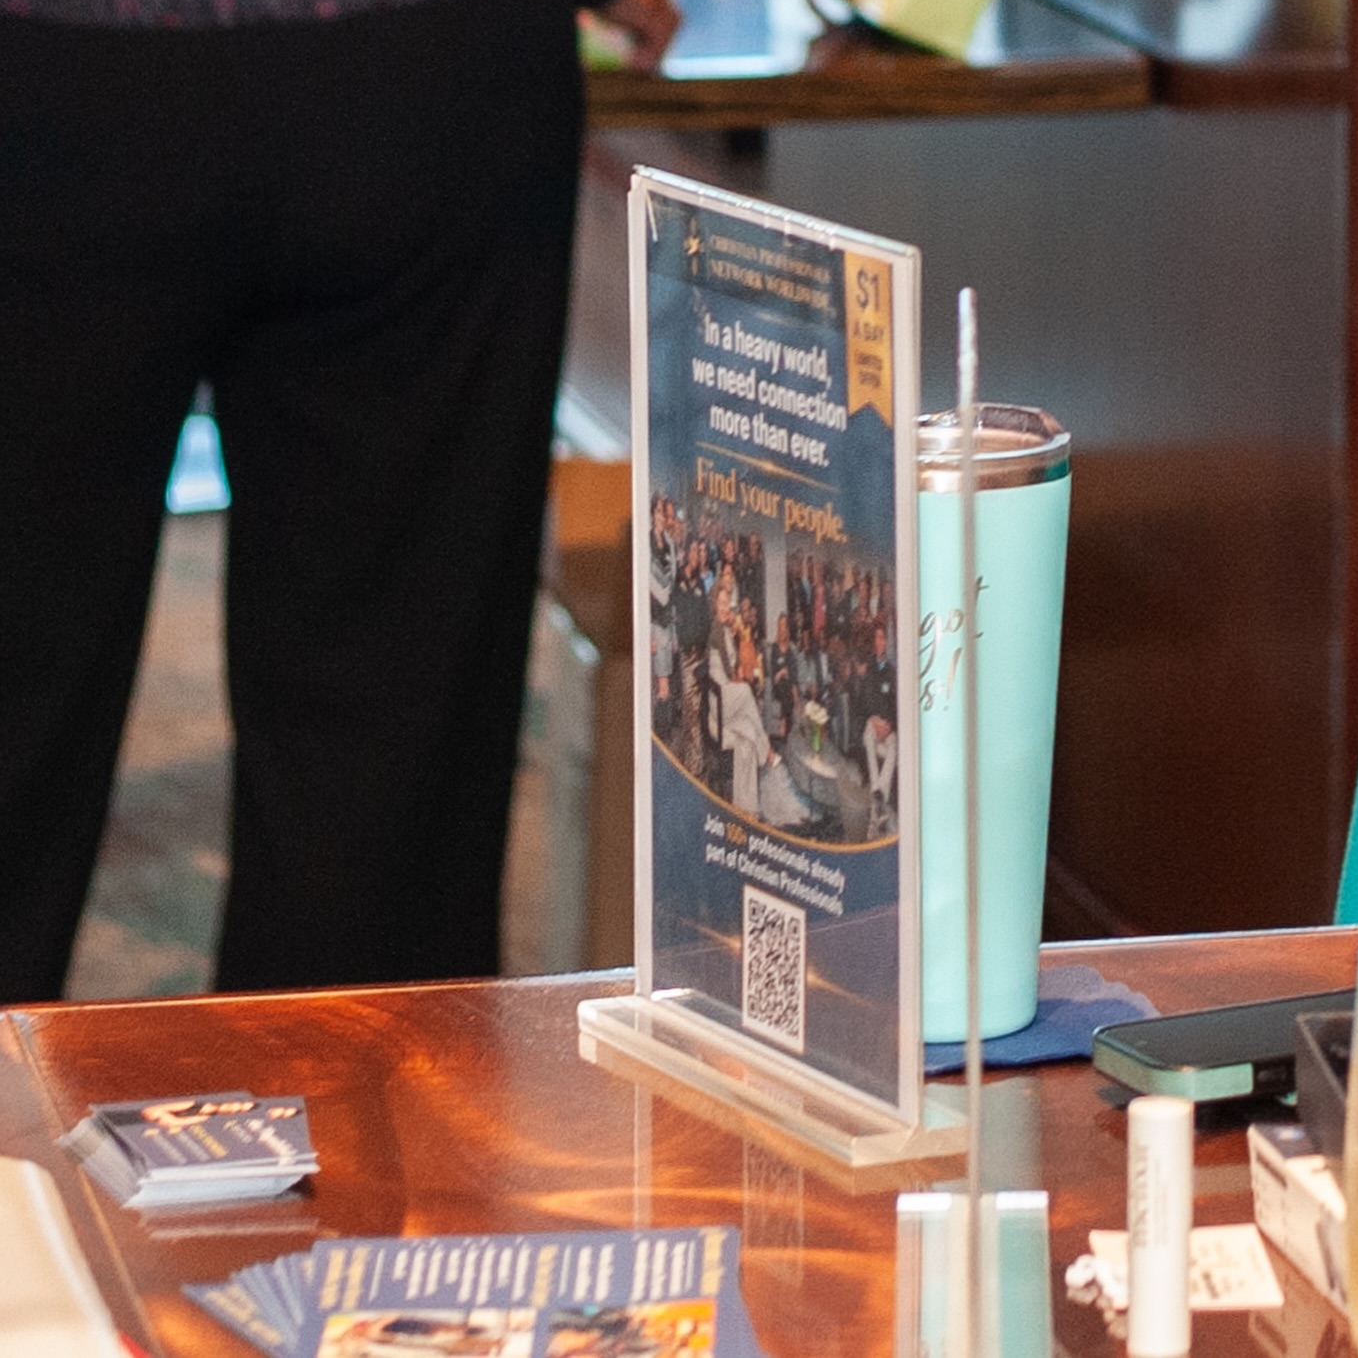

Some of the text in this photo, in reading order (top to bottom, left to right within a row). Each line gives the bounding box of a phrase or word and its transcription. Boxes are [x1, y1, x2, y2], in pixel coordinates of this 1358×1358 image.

[856, 268, 878, 312] $1
[704, 312, 720, 347] In
[722, 326, 733, 351] a
[734, 320, 781, 375] heavy
[783, 345, 832, 390] world,
[692, 357, 847, 432] we need connection
[710, 404, 830, 468] more than ever.
[696, 456, 848, 544] Find your people.
[705, 842, 726, 866] part
[726, 849, 738, 871] of
